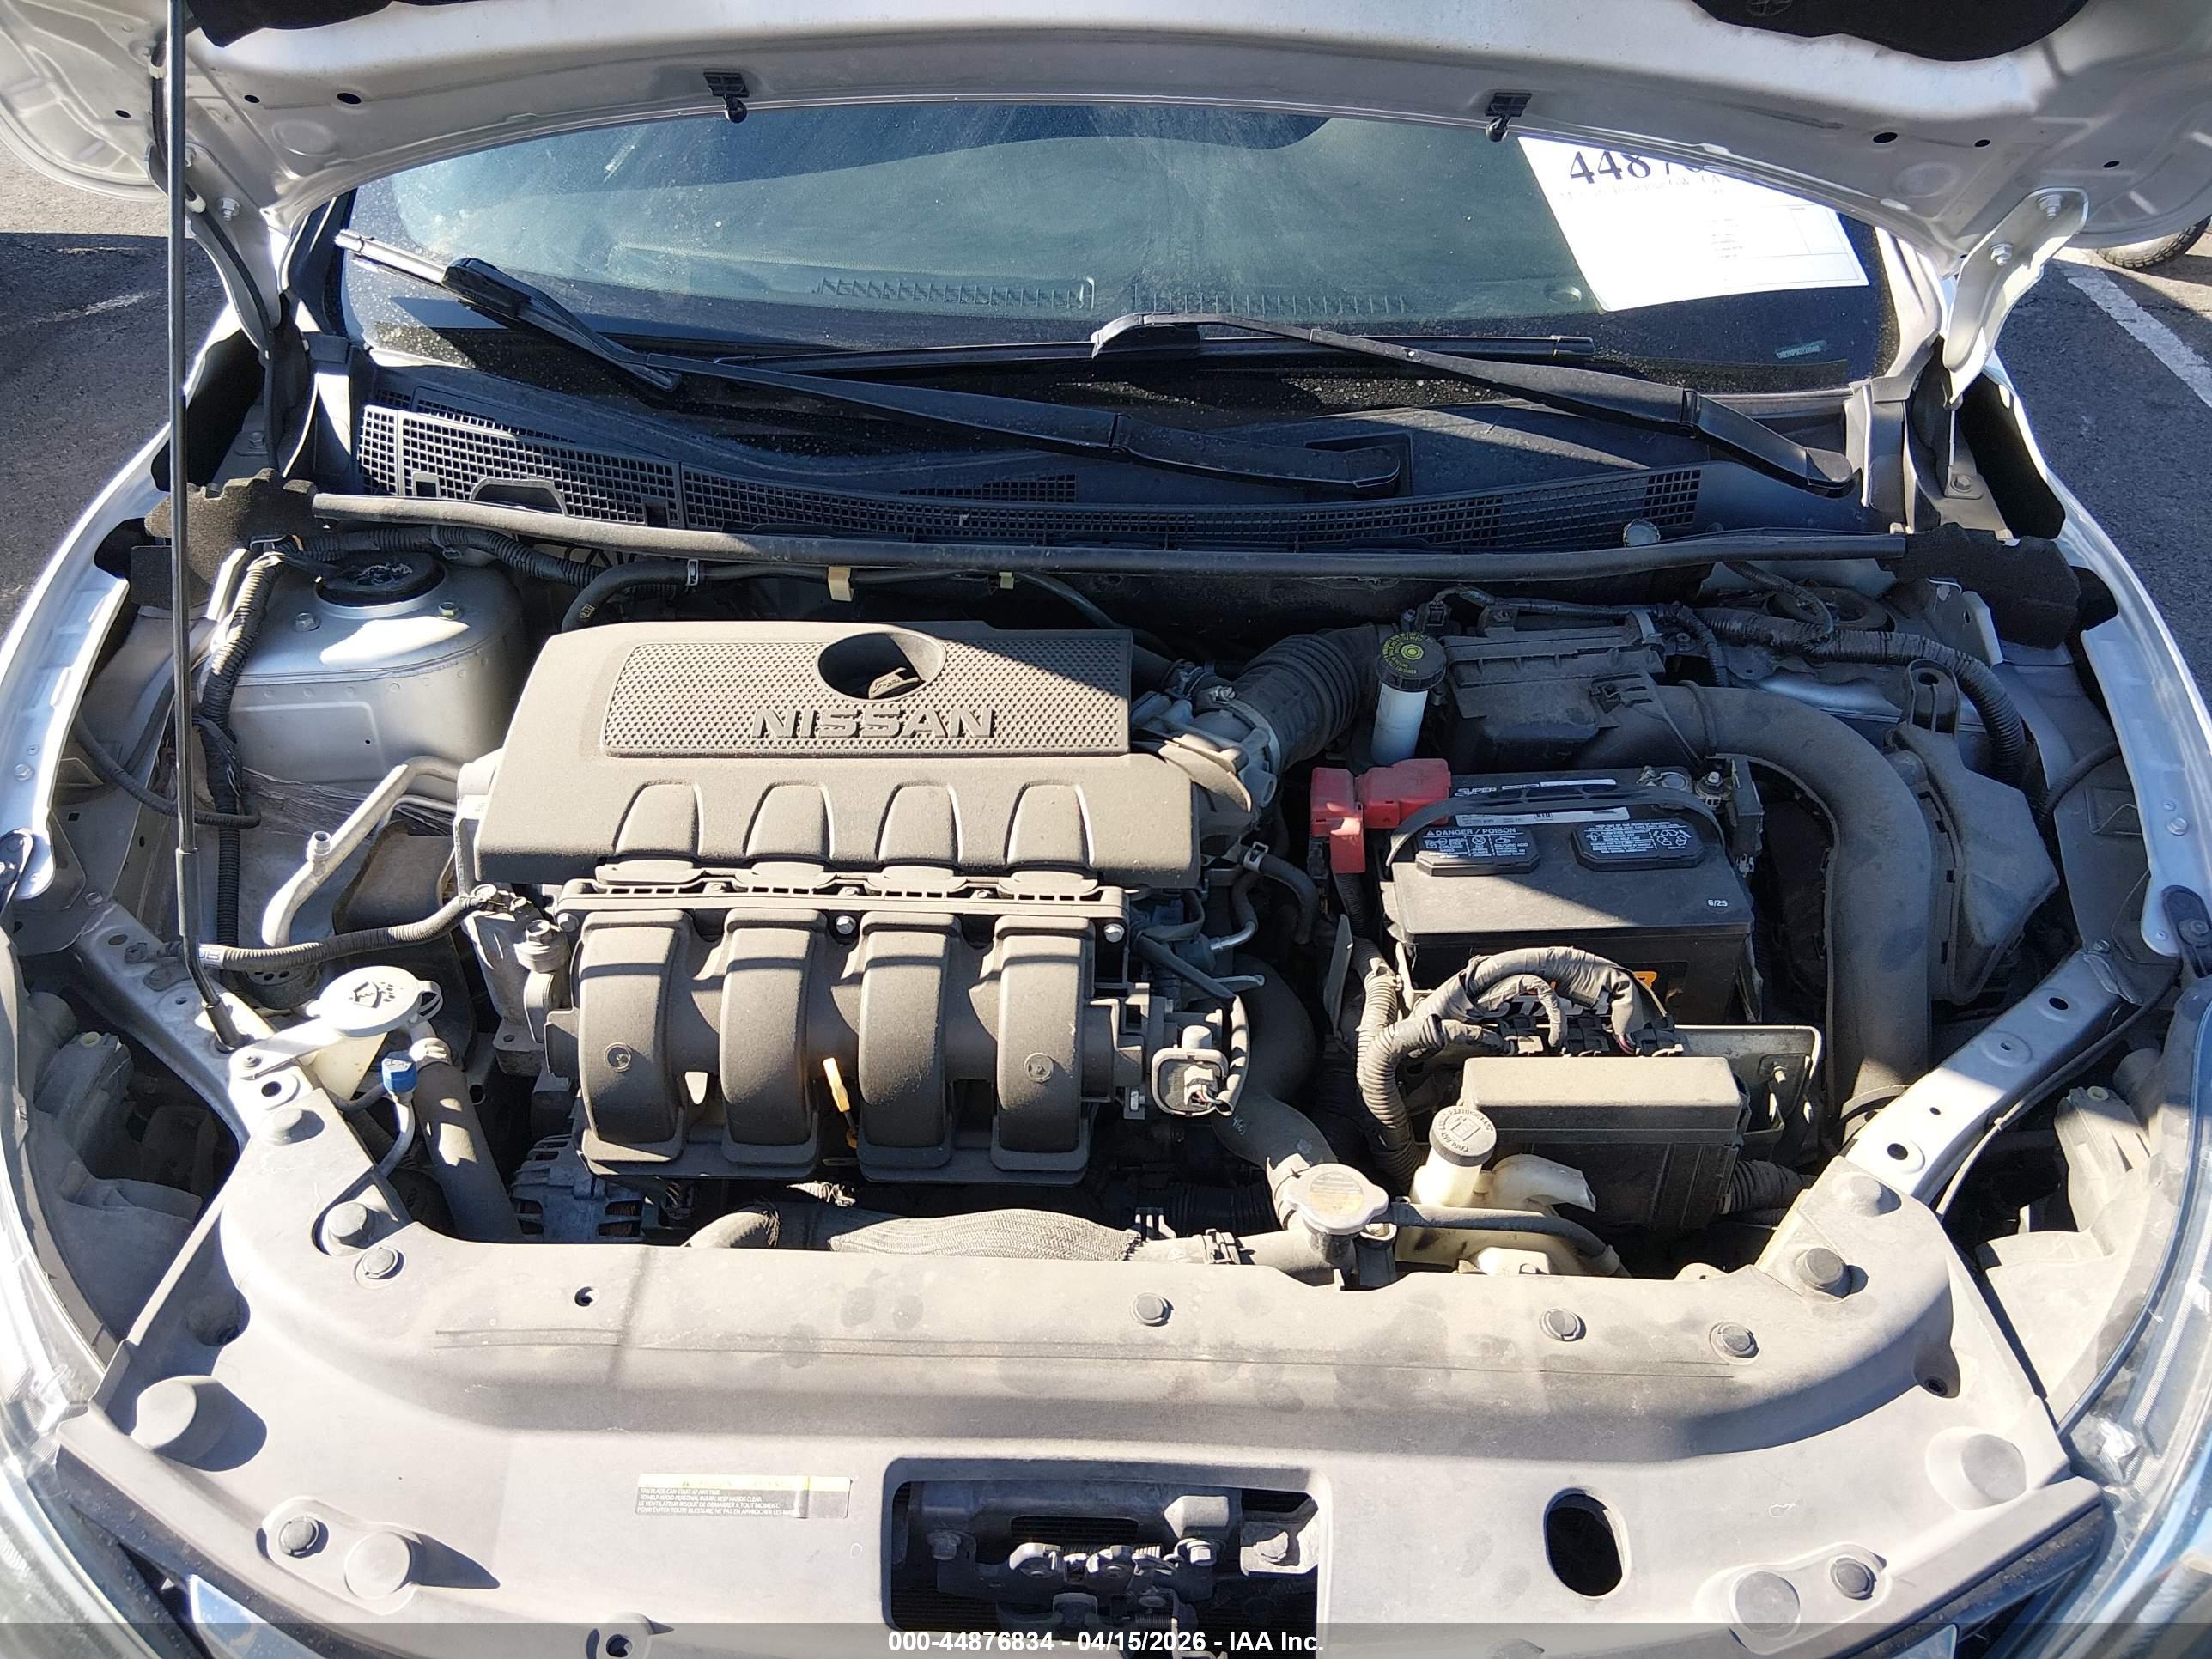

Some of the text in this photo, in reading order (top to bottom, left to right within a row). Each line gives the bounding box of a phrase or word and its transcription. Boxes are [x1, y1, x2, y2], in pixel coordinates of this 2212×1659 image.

[1570, 150, 1703, 185] 448
[751, 707, 996, 739] NISSAN
[1708, 899, 1728, 908] 6/25
